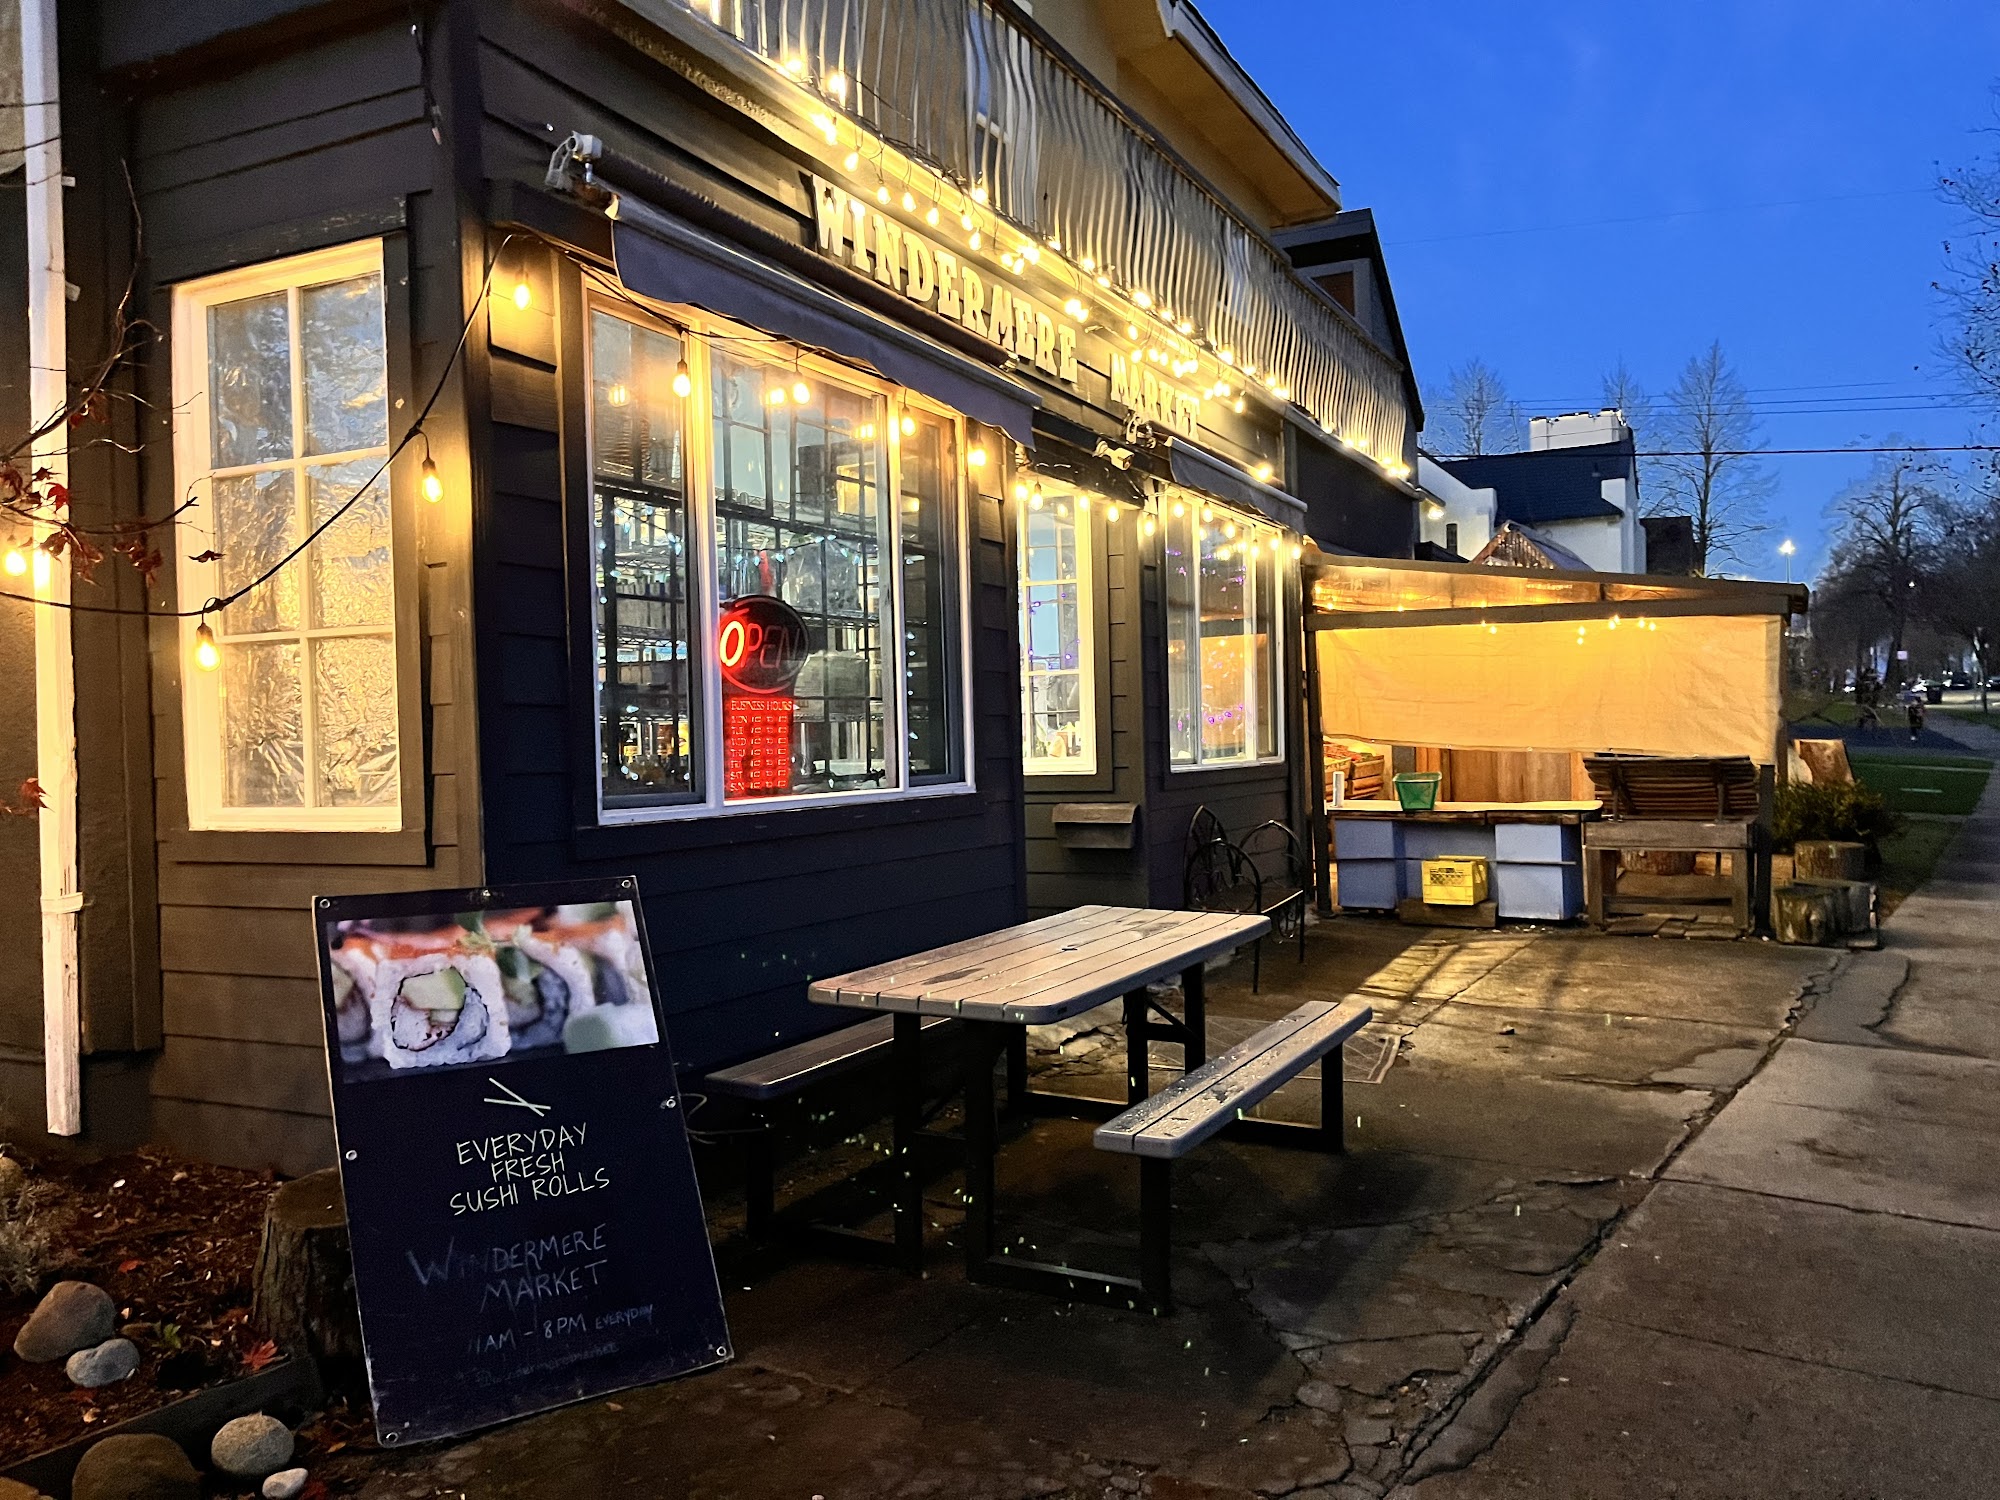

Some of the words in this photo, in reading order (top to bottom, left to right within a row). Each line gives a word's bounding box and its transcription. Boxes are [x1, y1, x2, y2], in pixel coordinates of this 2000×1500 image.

[812, 174, 1078, 383] WINDERMERE
[1110, 353, 1200, 439] MARKET
[719, 620, 801, 670] OPEN
[766, 700, 792, 711] HOURS
[456, 1121, 587, 1165] EVERYDAY
[491, 1151, 565, 1183] FRESH
[450, 1183, 519, 1216] SUSHI
[532, 1167, 610, 1200] ROLLS
[479, 1259, 608, 1313] MARKET
